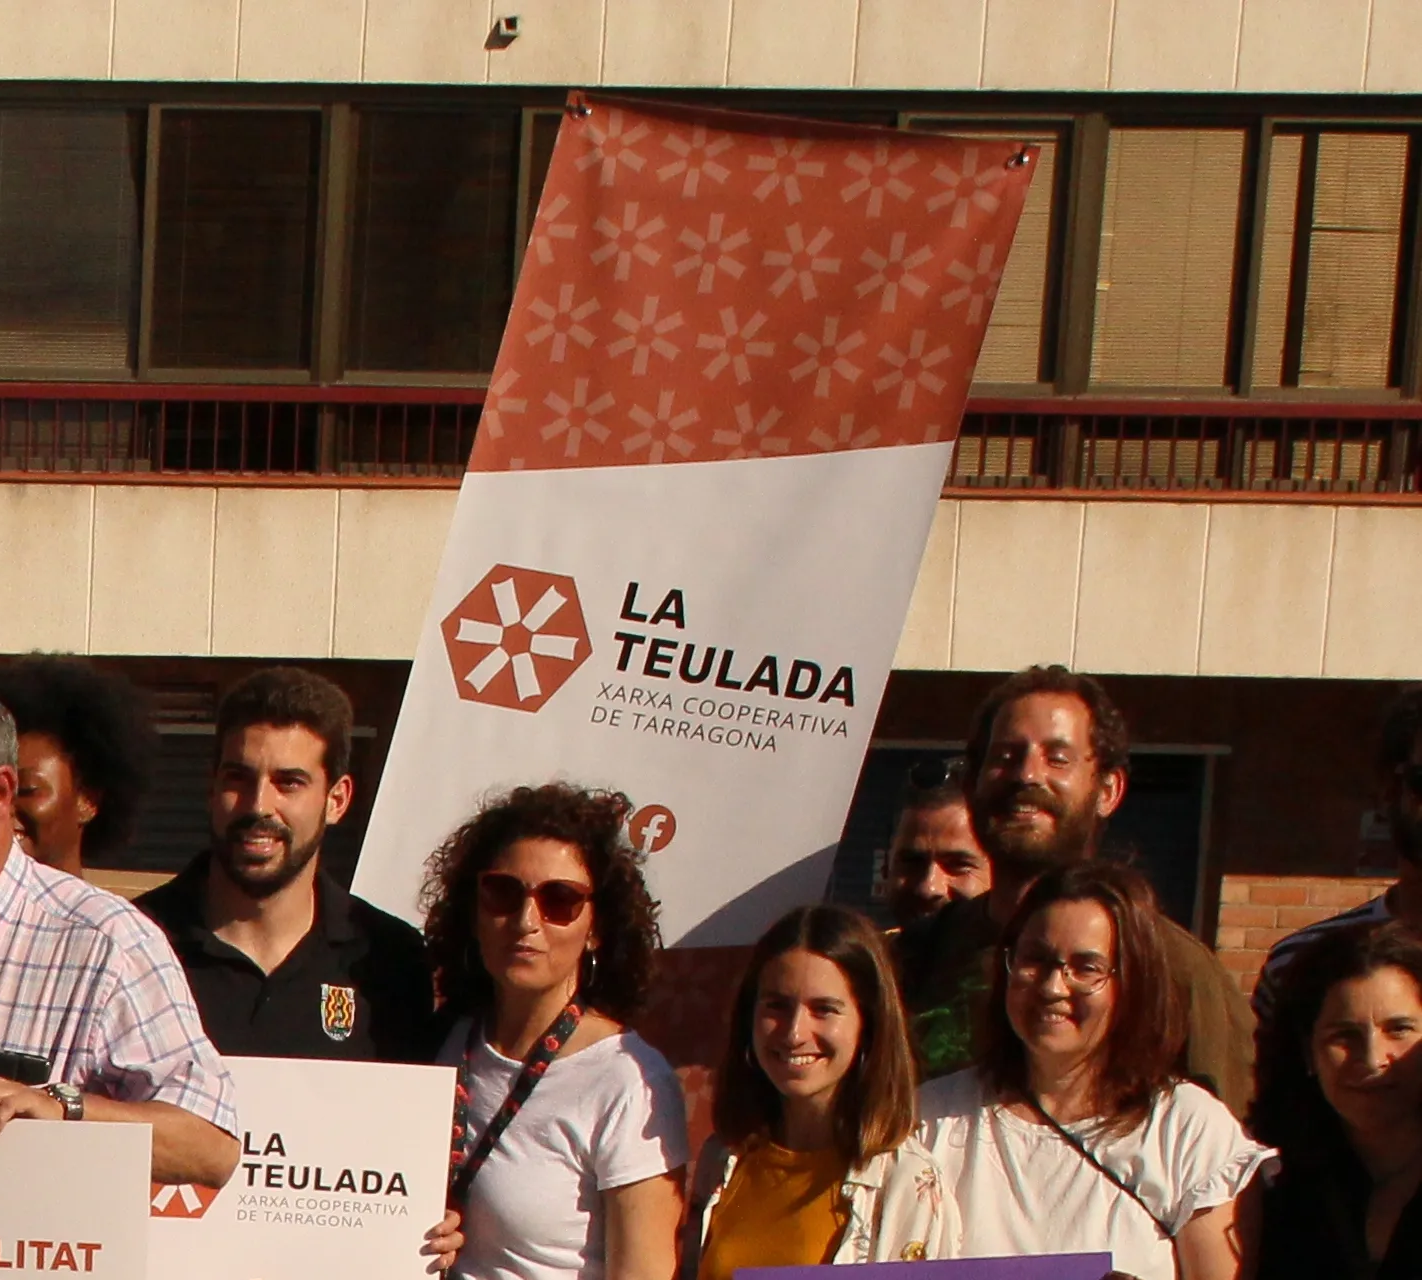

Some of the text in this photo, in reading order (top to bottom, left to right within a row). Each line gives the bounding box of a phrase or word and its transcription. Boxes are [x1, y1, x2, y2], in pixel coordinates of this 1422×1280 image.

[620, 581, 686, 629] LA
[614, 631, 856, 707] TEULADA
[590, 706, 777, 752] DE TARRAGONA
[596, 682, 848, 738] XARXA COOPERATIVA
[243, 1131, 287, 1157] LA
[242, 1163, 409, 1197] TEULADA
[236, 1209, 364, 1229] DE TARRAGONA
[237, 1194, 409, 1216] XARXA COOPERATIVA
